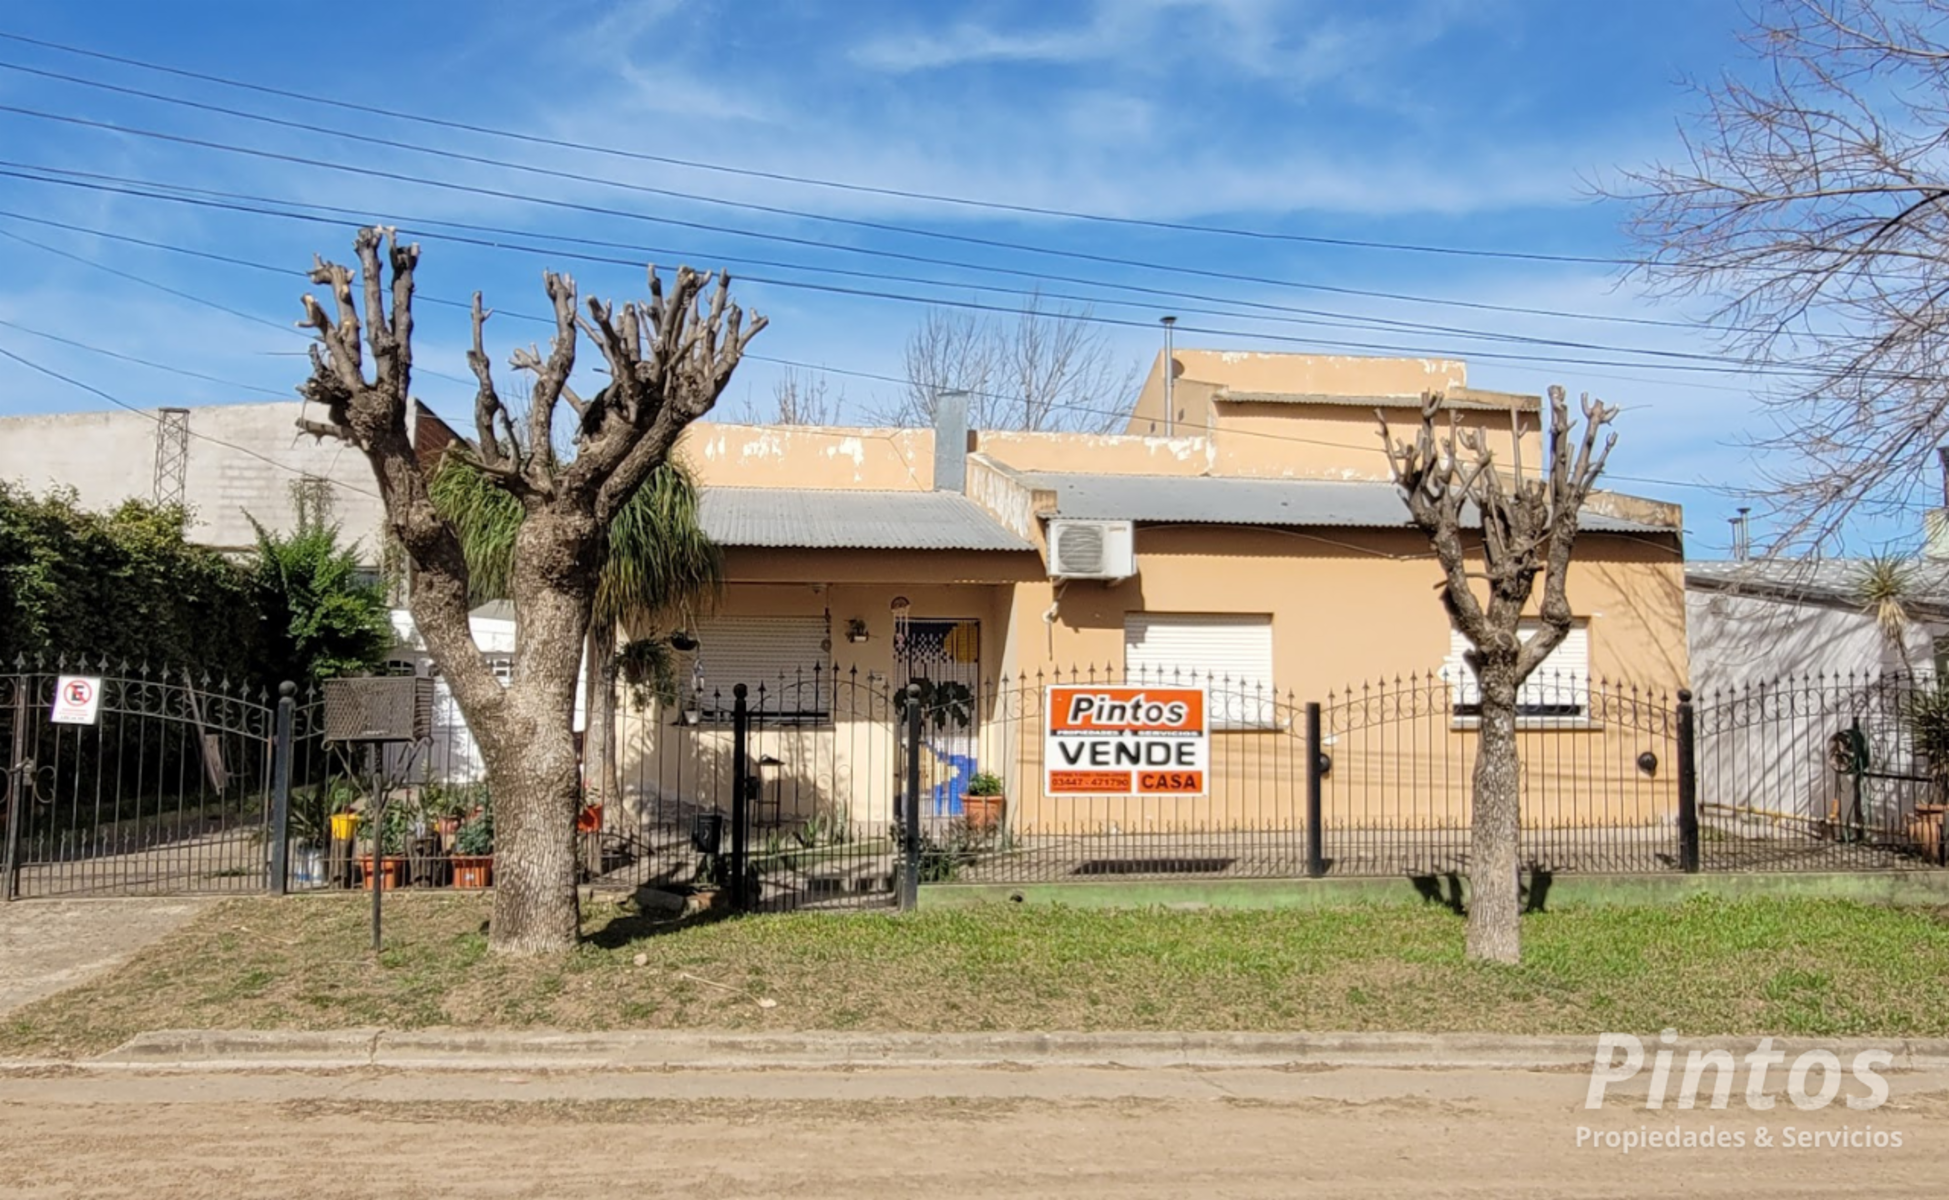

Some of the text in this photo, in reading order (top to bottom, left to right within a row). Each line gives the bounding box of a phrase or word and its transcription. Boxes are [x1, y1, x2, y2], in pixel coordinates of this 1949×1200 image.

[1069, 694, 1187, 725] Pintos
[1058, 741, 1196, 766] VENDE
[1141, 774, 1197, 789] CASA
